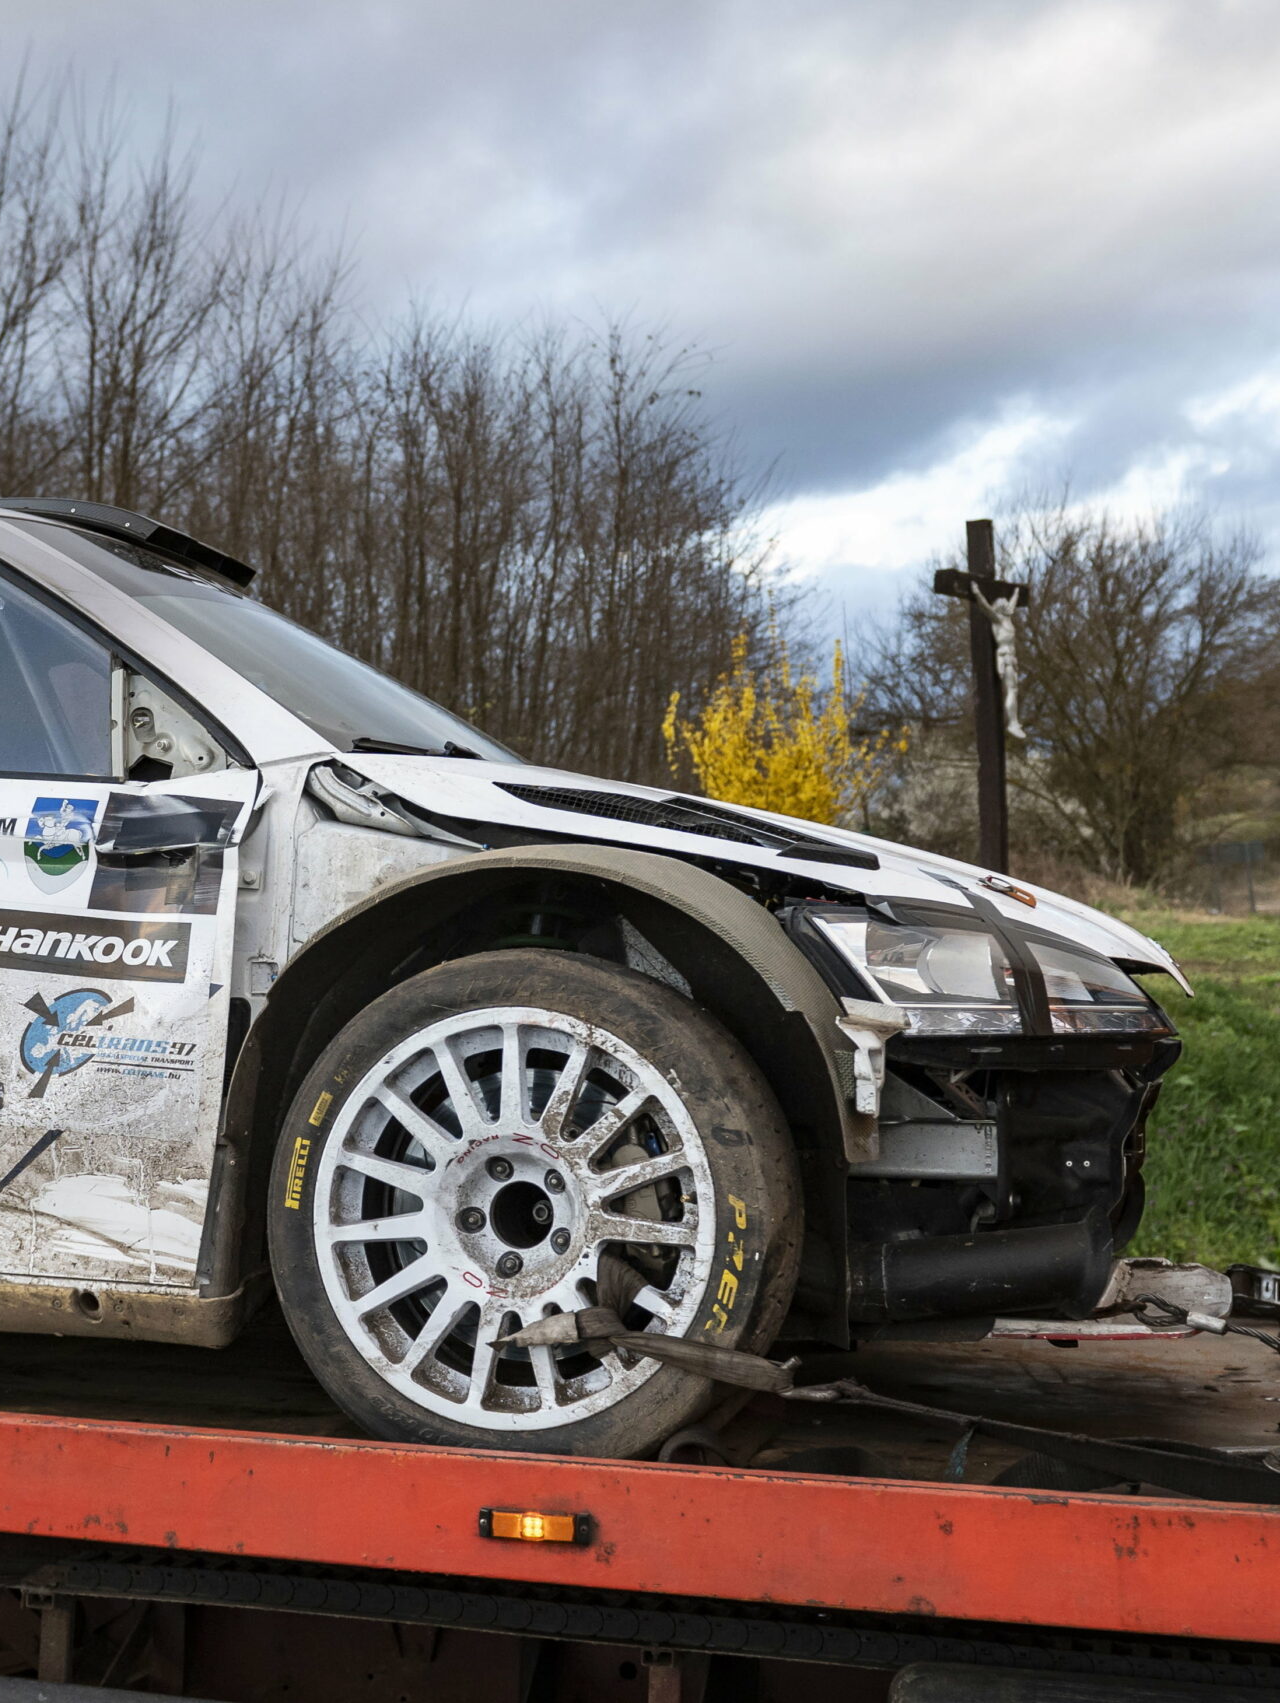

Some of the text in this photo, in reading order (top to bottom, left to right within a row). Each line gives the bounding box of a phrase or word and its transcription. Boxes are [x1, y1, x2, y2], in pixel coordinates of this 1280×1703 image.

[150, 1056, 195, 1066] TRANSPORT
[457, 1134, 499, 1165] RACING
[285, 1136, 311, 1210] PIRELLI
[728, 1193, 747, 1230] P
